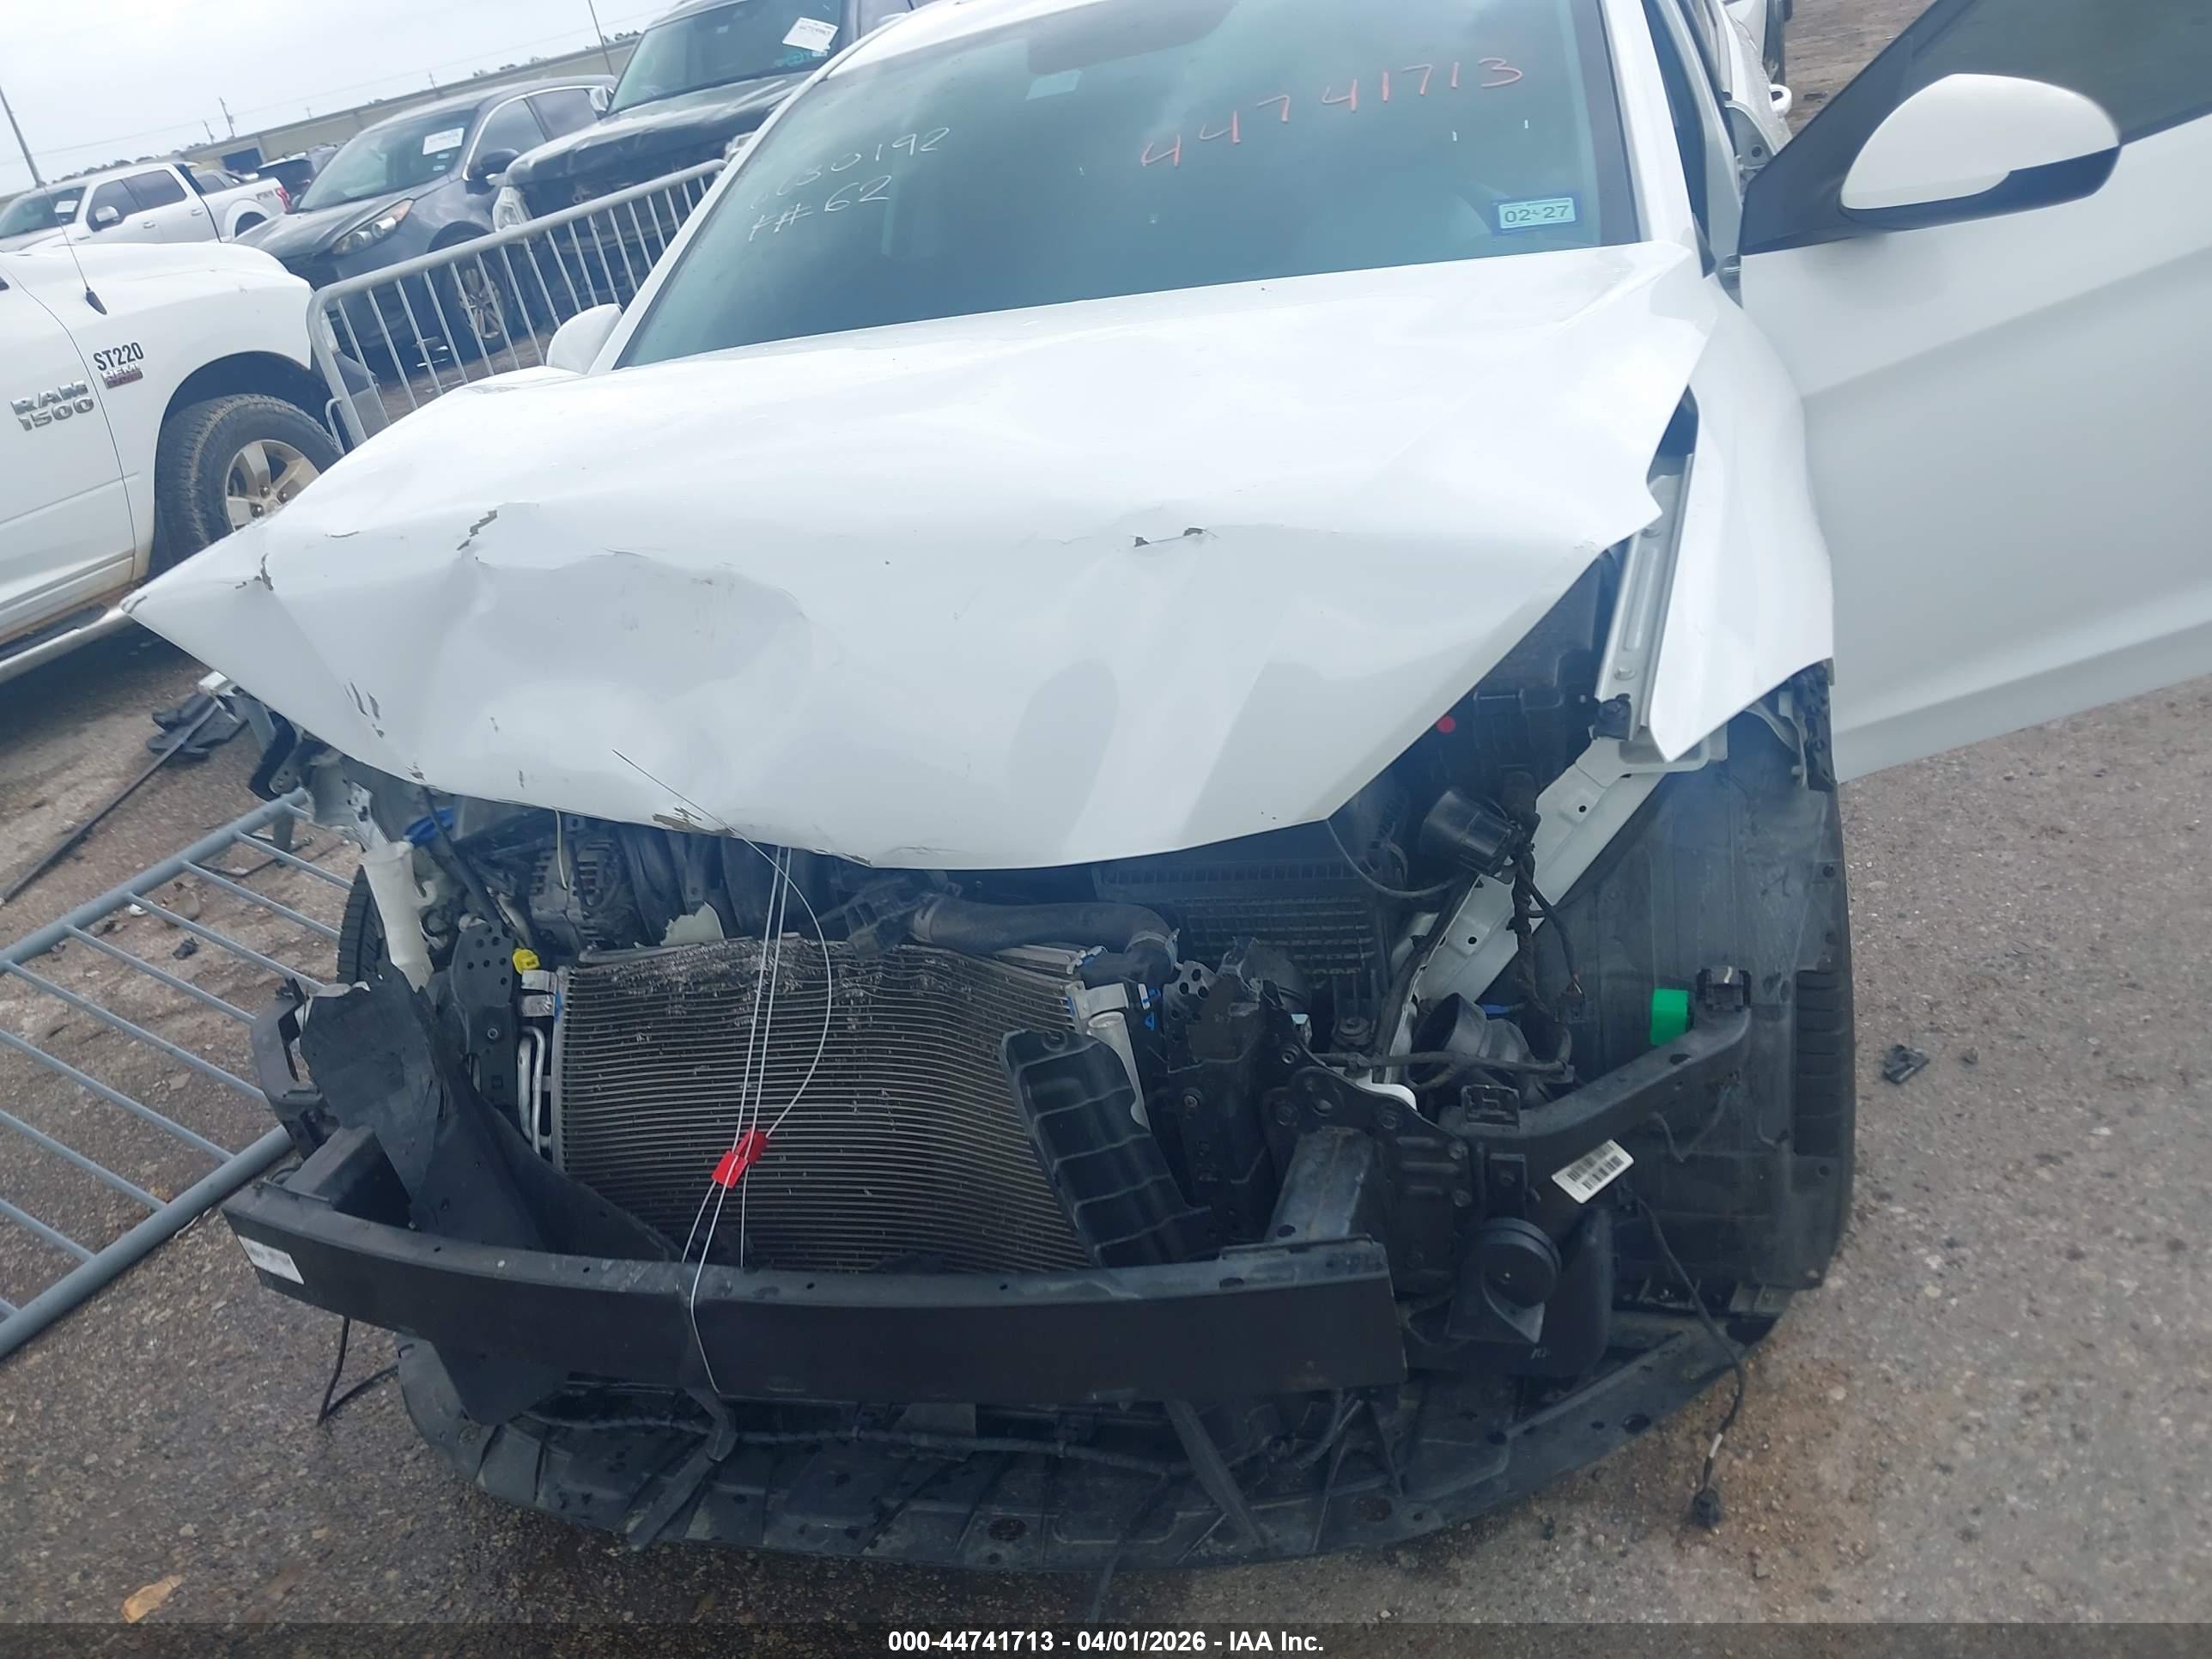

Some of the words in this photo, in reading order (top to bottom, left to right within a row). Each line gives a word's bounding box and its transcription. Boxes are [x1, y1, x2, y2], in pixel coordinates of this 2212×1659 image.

[1140, 58, 1523, 167] 44741713
[93, 342, 144, 371] ST220
[10, 380, 88, 415] RAM
[18, 397, 94, 430] 1500
